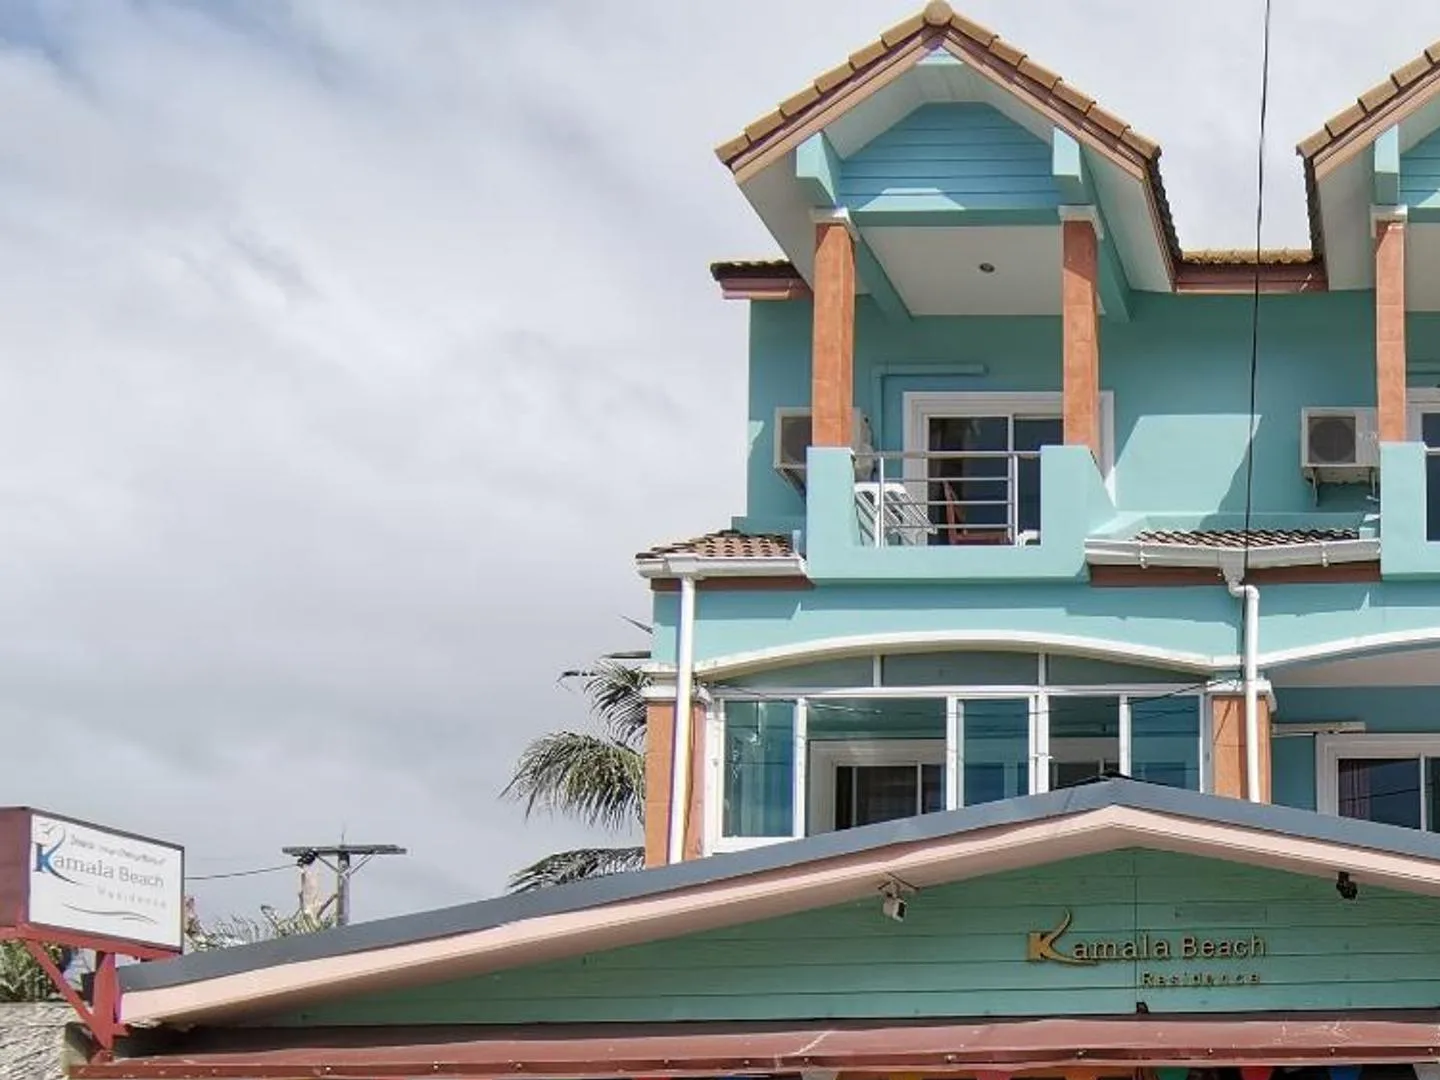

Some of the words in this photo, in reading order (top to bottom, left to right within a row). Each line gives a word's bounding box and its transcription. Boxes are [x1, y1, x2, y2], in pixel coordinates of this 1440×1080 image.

[34, 829, 114, 884] Kamala
[119, 866, 165, 887] Beach
[1026, 906, 1170, 966] Kamala
[1180, 935, 1267, 959] Beach
[1143, 970, 1261, 986] Residence
